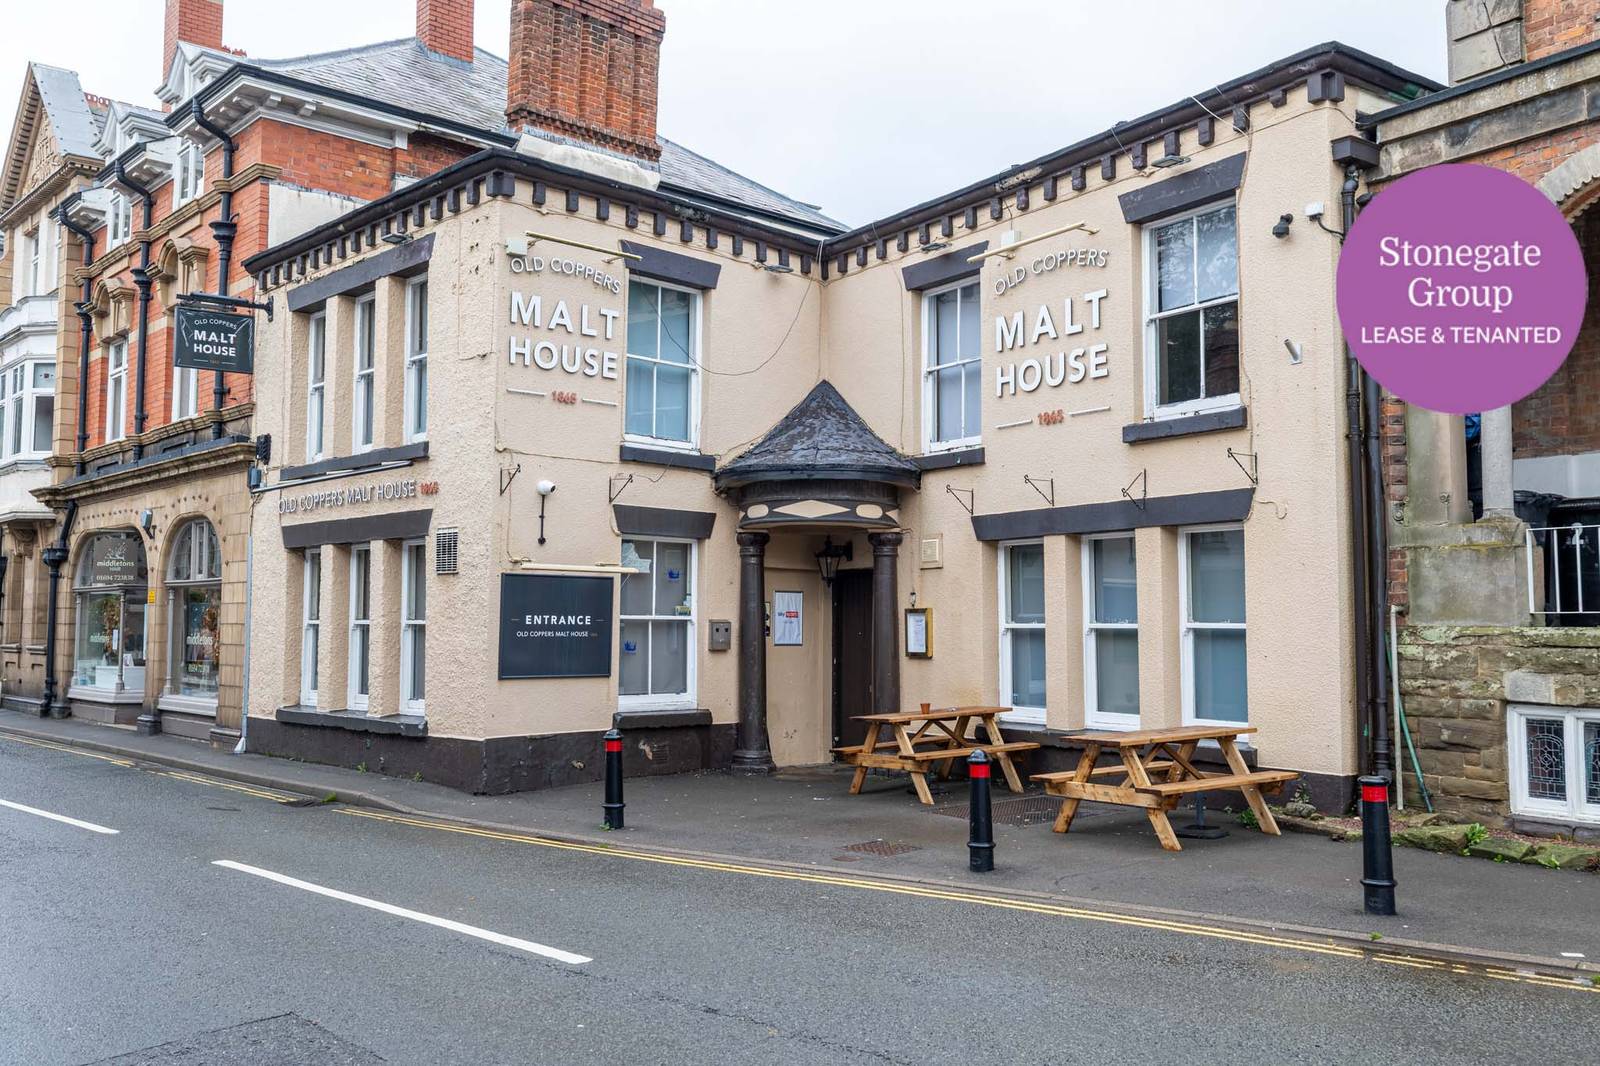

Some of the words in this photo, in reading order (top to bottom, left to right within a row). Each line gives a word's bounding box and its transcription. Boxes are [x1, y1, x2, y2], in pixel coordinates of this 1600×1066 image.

[510, 256, 545, 273] OLD
[550, 257, 622, 294] COPPERS
[994, 266, 1027, 296] OLD
[1031, 248, 1109, 275] COPPERS
[194, 318, 208, 326] OLD
[208, 318, 238, 330] COPPERS
[510, 291, 620, 340] MALT
[995, 288, 1108, 353] MALT
[193, 329, 237, 345] MALT
[193, 343, 237, 357] HOUSE
[508, 335, 619, 379] HOUSE
[996, 343, 1109, 398] HOUSE
[278, 498, 298, 514] OLD
[299, 492, 344, 511] COPPERS
[346, 485, 375, 503] MALT
[377, 479, 417, 499] HOUSE
[96, 560, 135, 568] middletons
[516, 630, 529, 638] OLD
[529, 630, 555, 638] COPPERS
[555, 630, 569, 638] MALT
[570, 630, 589, 638] HOUSE
[525, 615, 592, 625] ENTRANCE
